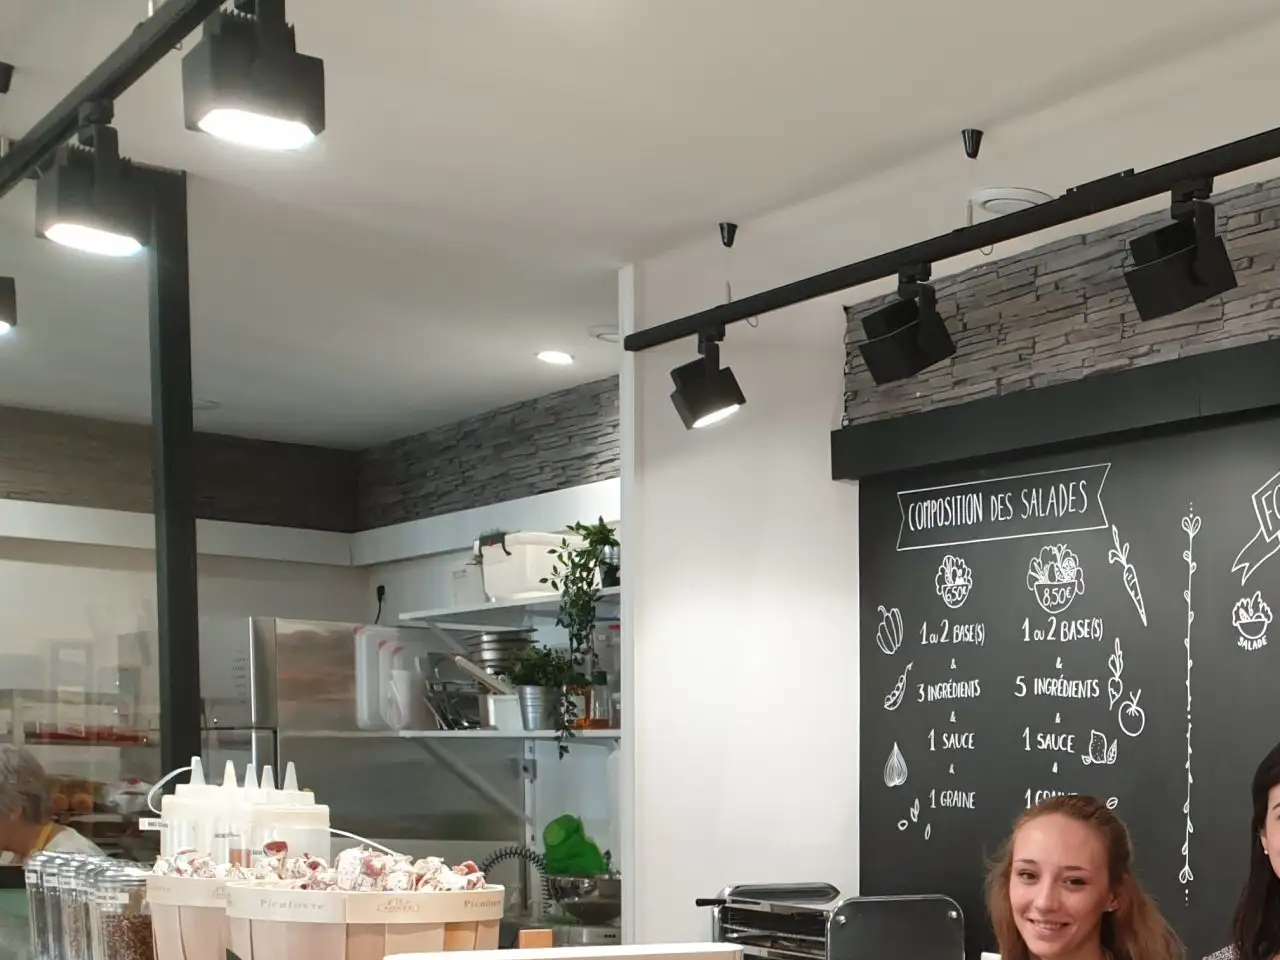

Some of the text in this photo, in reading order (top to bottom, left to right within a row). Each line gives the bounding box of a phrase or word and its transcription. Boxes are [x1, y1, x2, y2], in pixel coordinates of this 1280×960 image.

[908, 480, 1088, 532] COMPOSITION DES SALADES
[920, 621, 928, 645] 1
[940, 620, 950, 643] 2
[952, 622, 986, 647] BASE(S)
[1022, 618, 1030, 643] 1
[1047, 616, 1057, 640] 2
[1060, 617, 1104, 643] BASE(S)
[1237, 635, 1268, 651] SALADE
[917, 676, 981, 703] 3 INGRÉDIENTS
[1014, 674, 1100, 699] 5 INGRÉDIENTS
[928, 728, 975, 752] 1 SAUCE
[1022, 727, 1075, 753] 1 SAUCE
[929, 789, 976, 810] 1 GRAINE
[1024, 789, 1032, 809] 1
